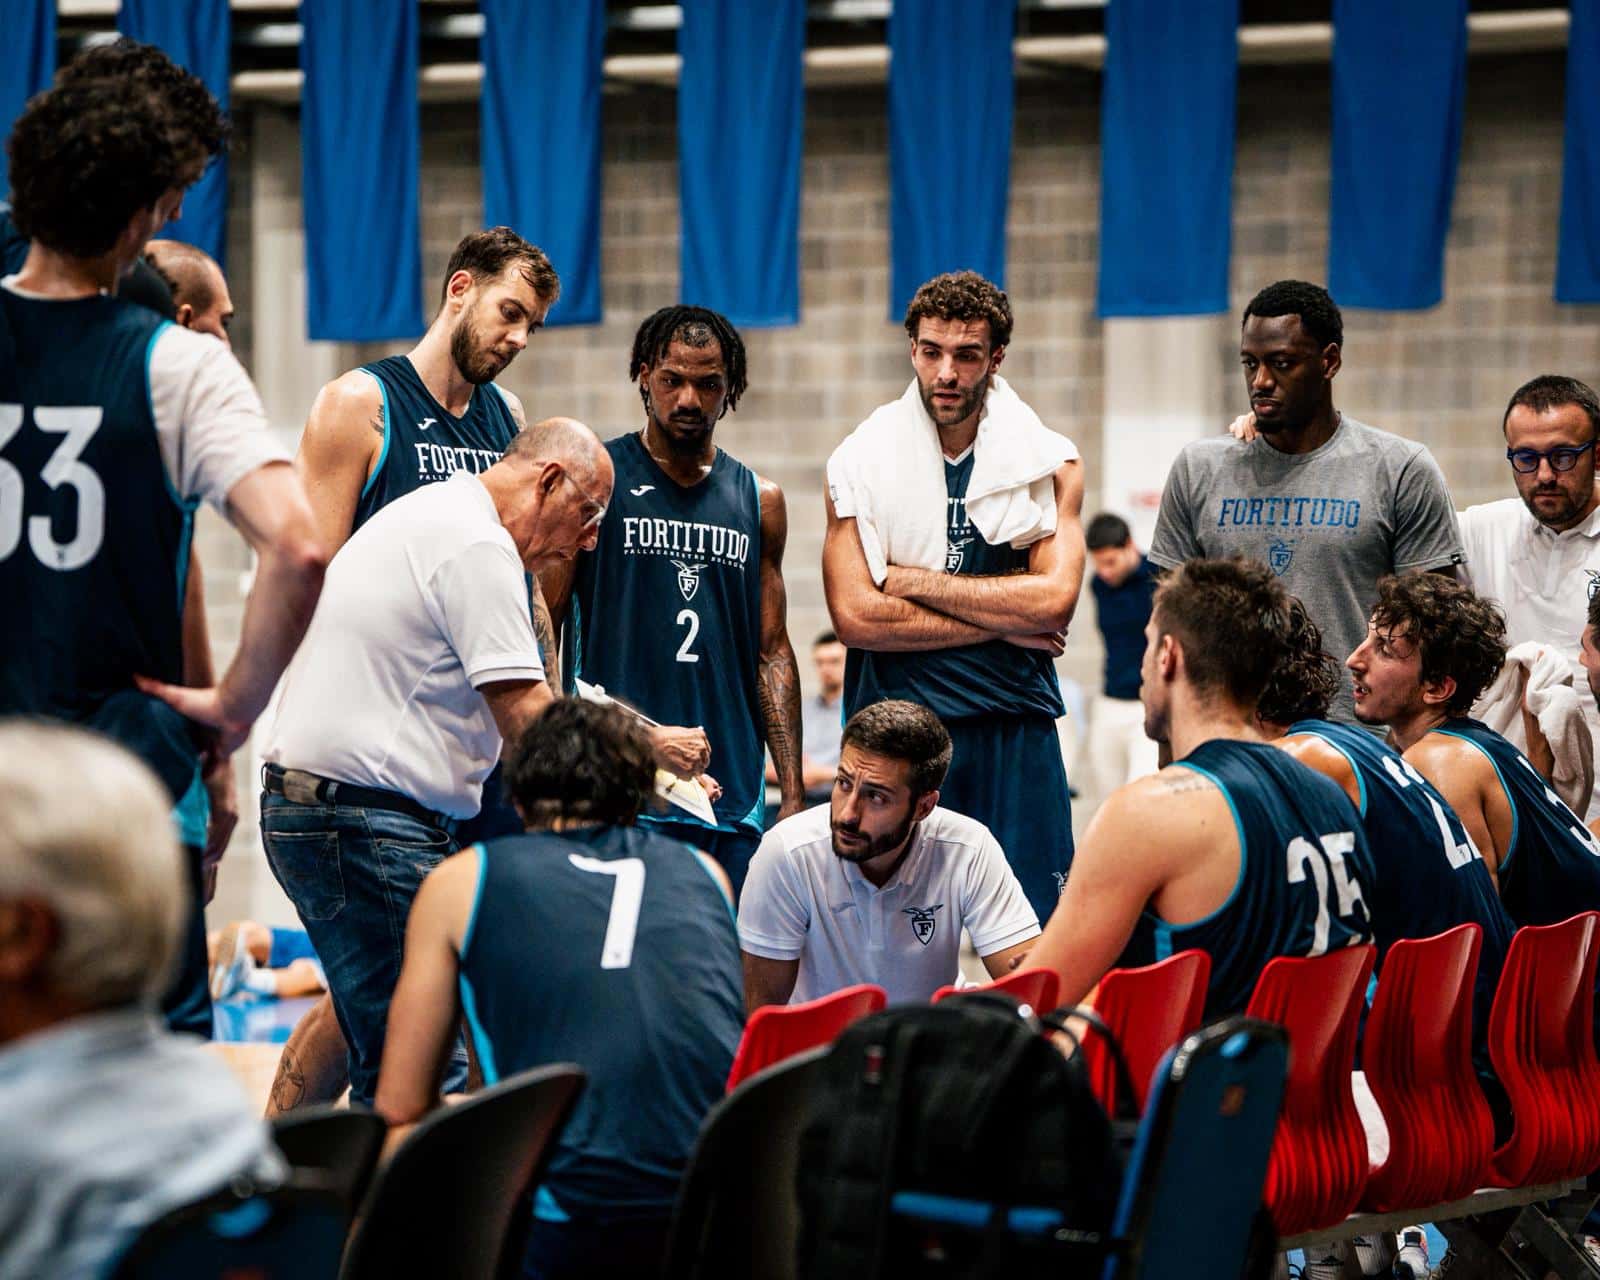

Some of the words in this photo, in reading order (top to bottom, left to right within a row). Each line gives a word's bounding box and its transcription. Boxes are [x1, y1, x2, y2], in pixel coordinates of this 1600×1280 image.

[1217, 497, 1361, 528] FORTITUDO
[623, 517, 750, 563] FORTITUDO
[682, 578, 695, 592] F
[675, 609, 700, 663] 2
[567, 853, 646, 970] 7
[1286, 832, 1375, 957] 25
[918, 922, 932, 936] F
